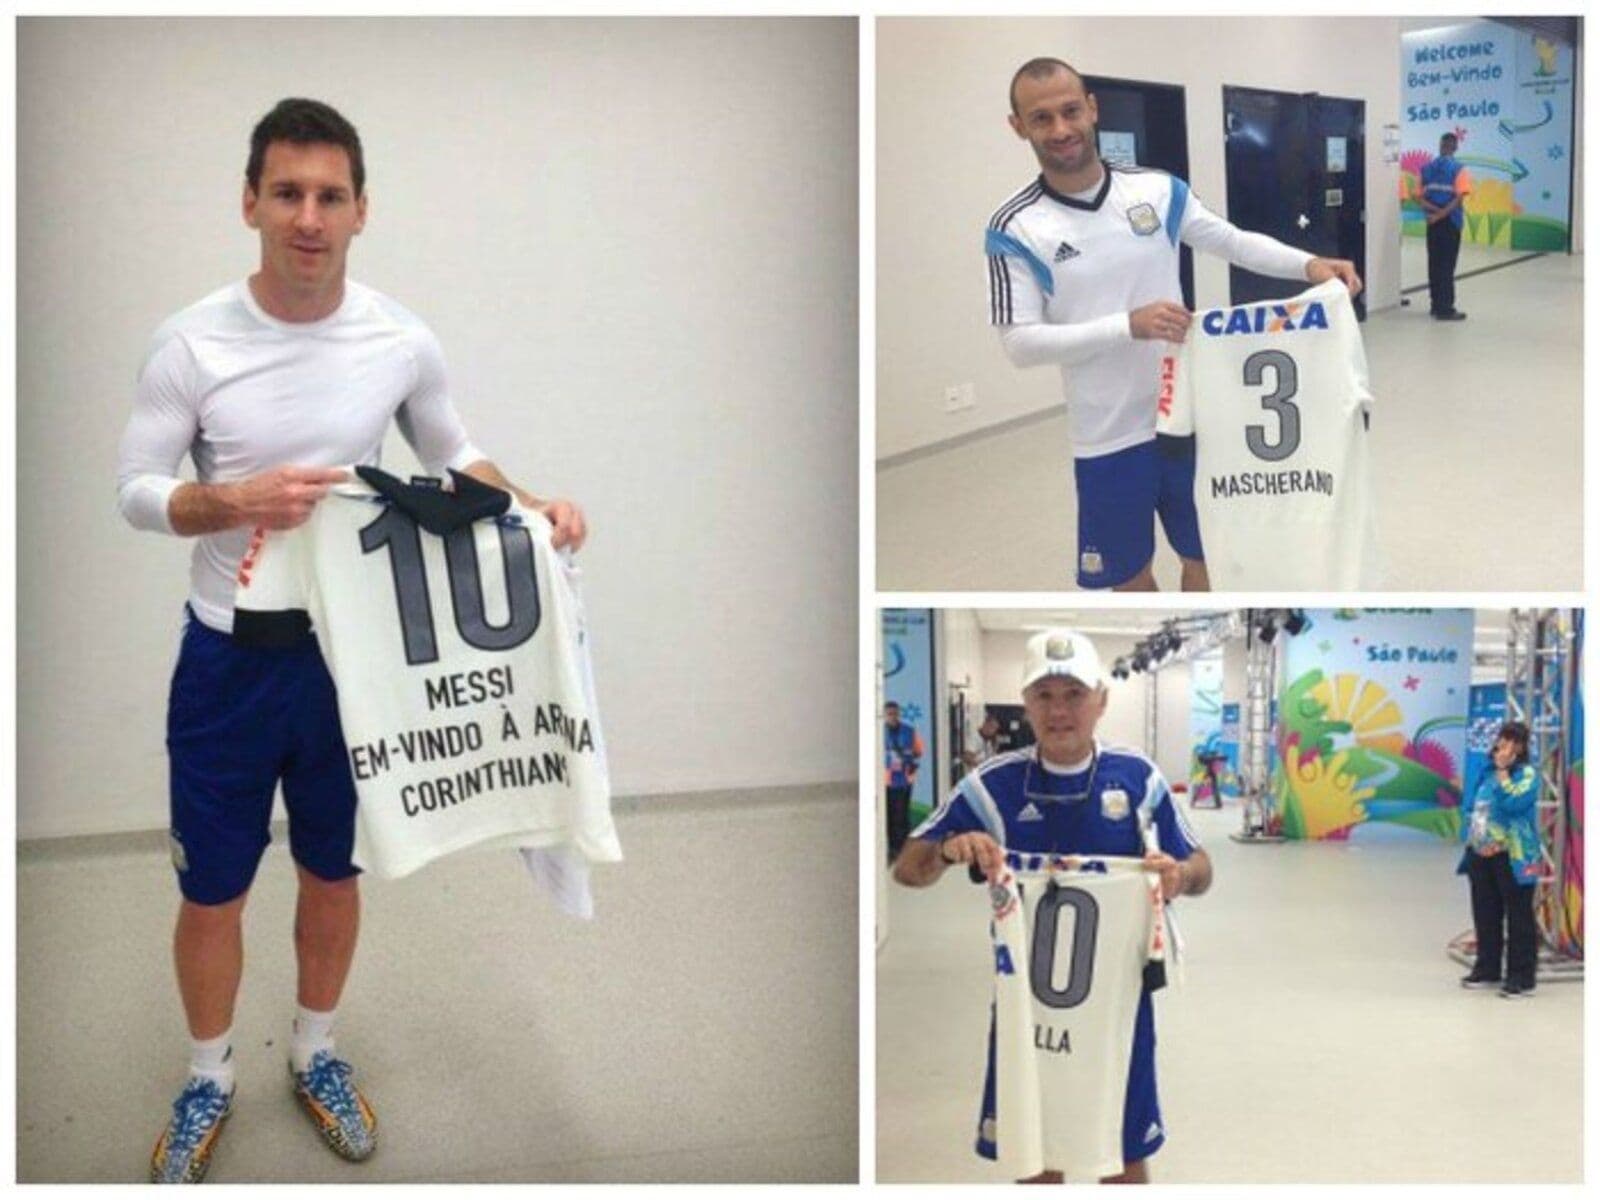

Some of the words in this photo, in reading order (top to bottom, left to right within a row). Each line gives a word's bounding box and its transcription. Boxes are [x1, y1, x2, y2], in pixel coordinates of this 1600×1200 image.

[1407, 102, 1440, 122] São
[1446, 100, 1500, 120] Paulo
[1202, 302, 1329, 336] CAIXA
[1243, 349, 1301, 462] 3
[1210, 469, 1334, 498] MASCHERANO
[359, 503, 542, 666] 10
[1366, 643, 1402, 661] São
[1407, 645, 1459, 663] Paulo
[424, 665, 514, 711] MESSI
[351, 721, 484, 781] EM-VINDO
[502, 704, 520, 742] À
[534, 702, 596, 753] ARNA
